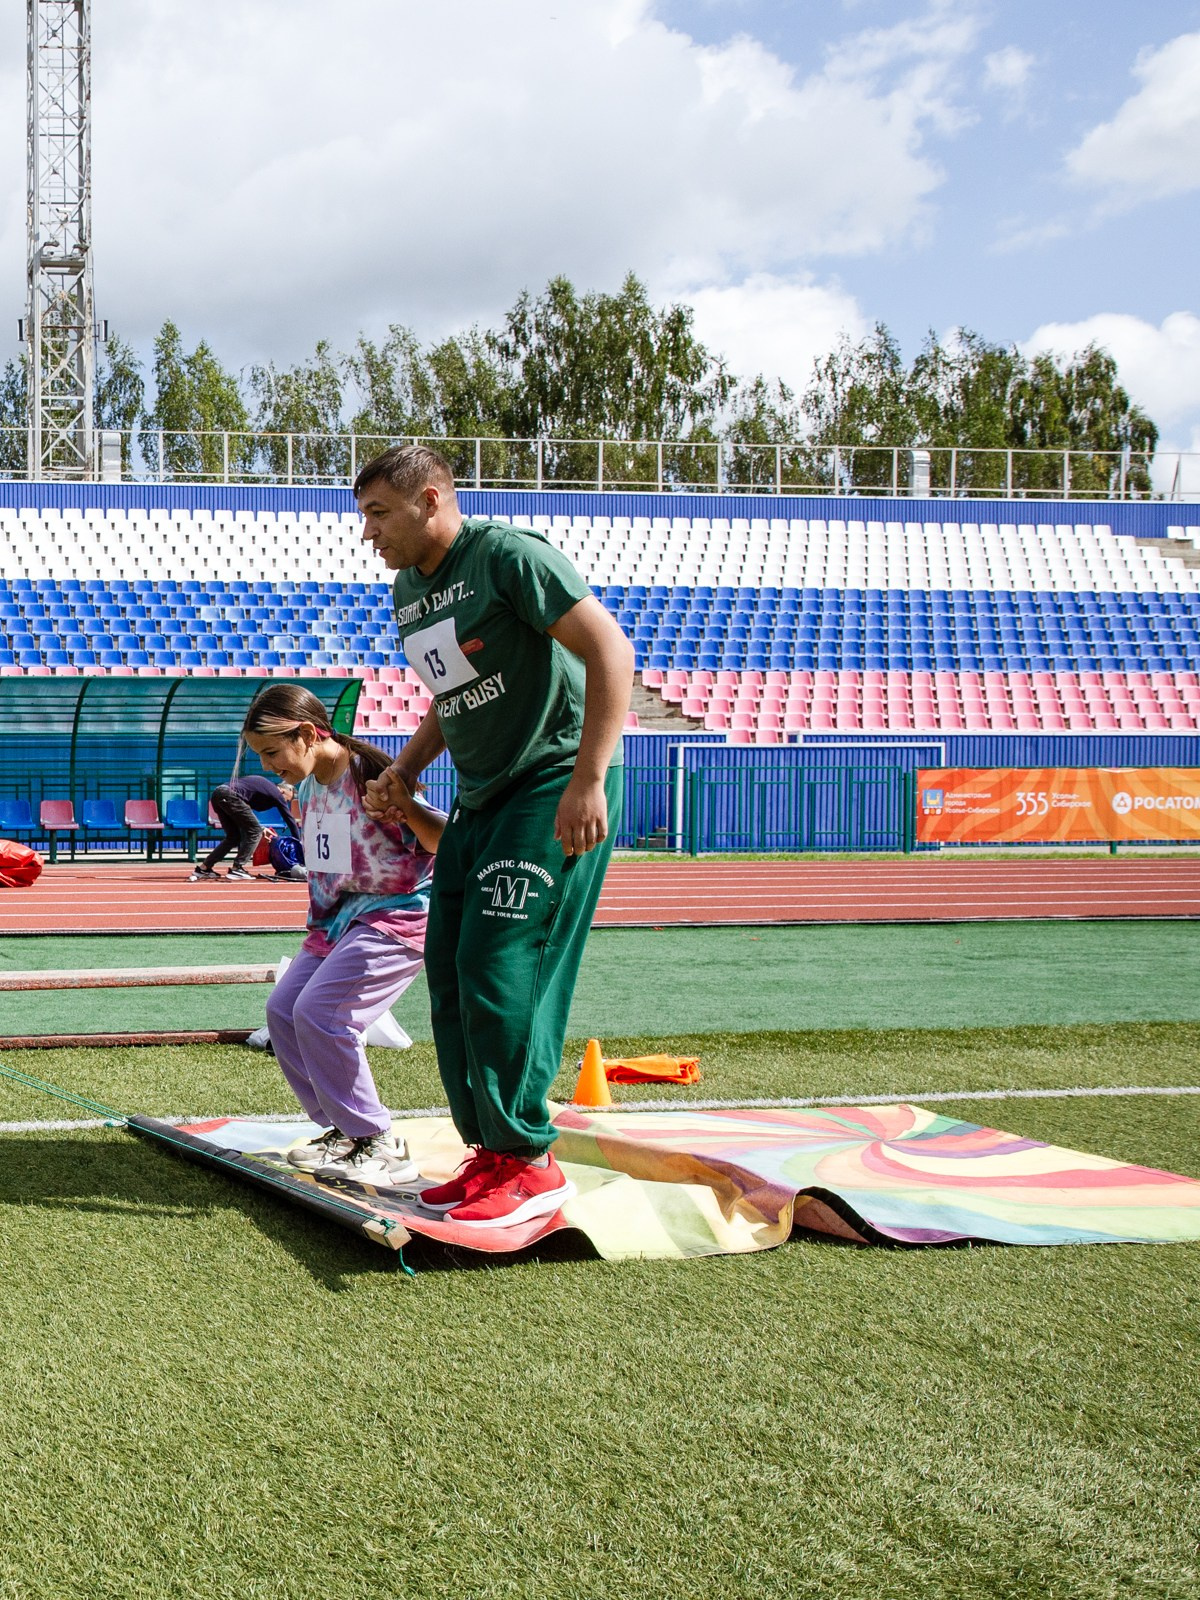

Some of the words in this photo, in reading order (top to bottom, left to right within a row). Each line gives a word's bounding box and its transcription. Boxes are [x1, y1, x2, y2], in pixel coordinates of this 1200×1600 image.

[424, 648, 447, 680] 13
[462, 672, 506, 710] BUSY
[1015, 791, 1049, 816] 355
[315, 833, 330, 860] 13
[476, 859, 516, 882] MAJESTIC
[516, 860, 556, 889] AMBITION
[491, 874, 530, 910] M
